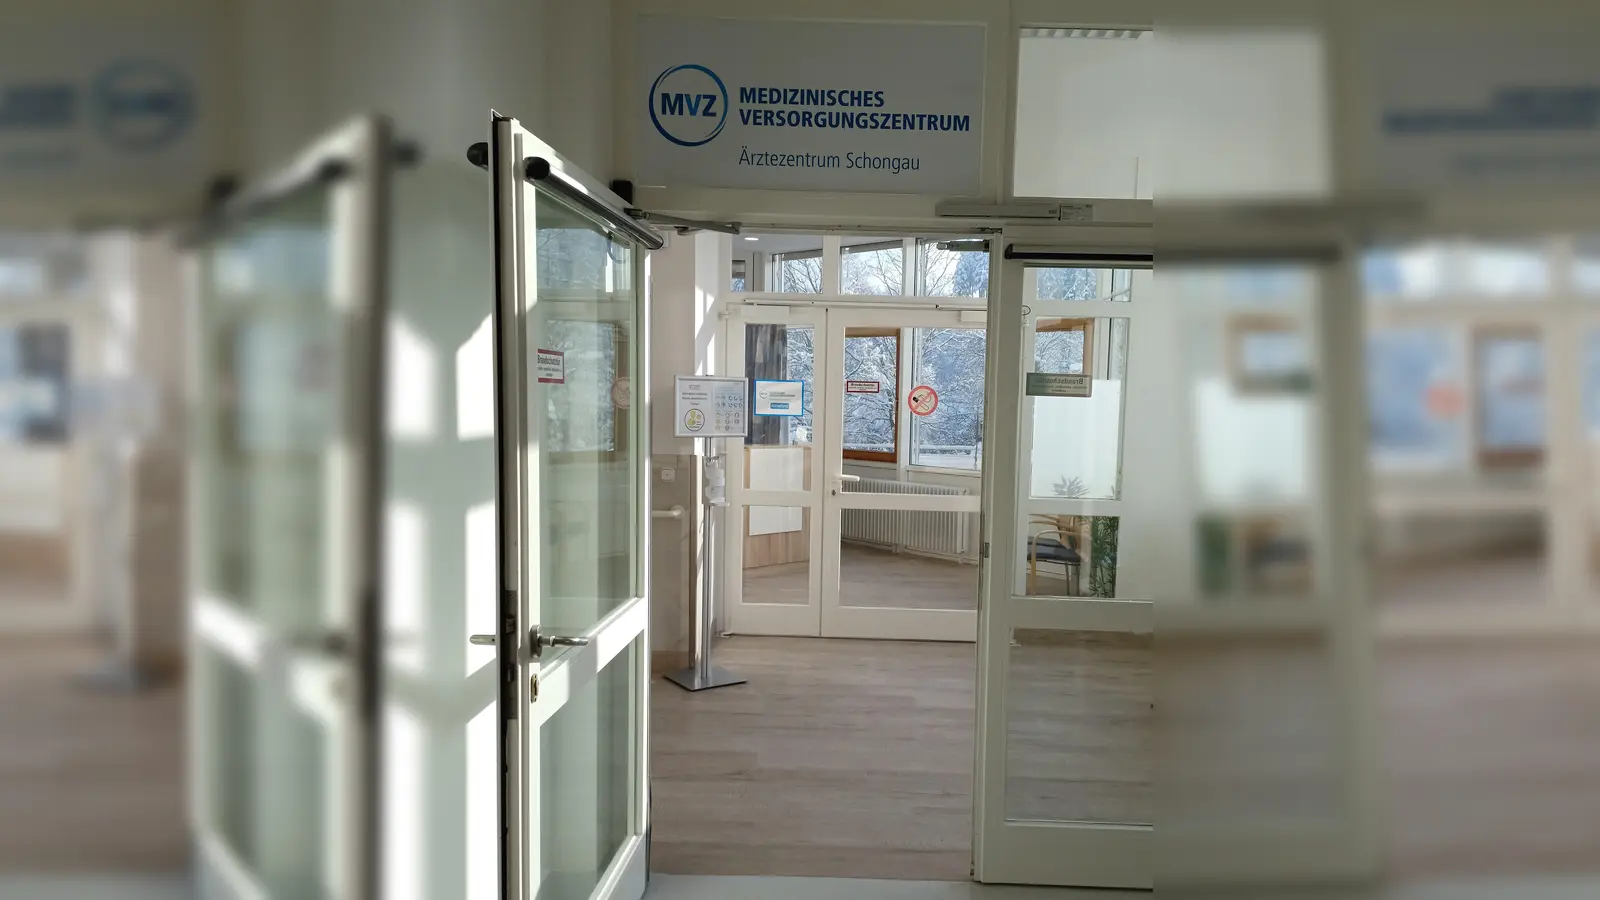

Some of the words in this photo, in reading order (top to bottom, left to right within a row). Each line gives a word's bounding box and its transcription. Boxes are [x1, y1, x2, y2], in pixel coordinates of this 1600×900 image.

[660, 92, 718, 117] MVZ
[739, 87, 885, 108] MEDIZINISCHES
[739, 109, 970, 132] VERSORGUNGSZENTRUM
[738, 146, 841, 169] Ärztezentrum
[846, 151, 920, 174] Schongau
